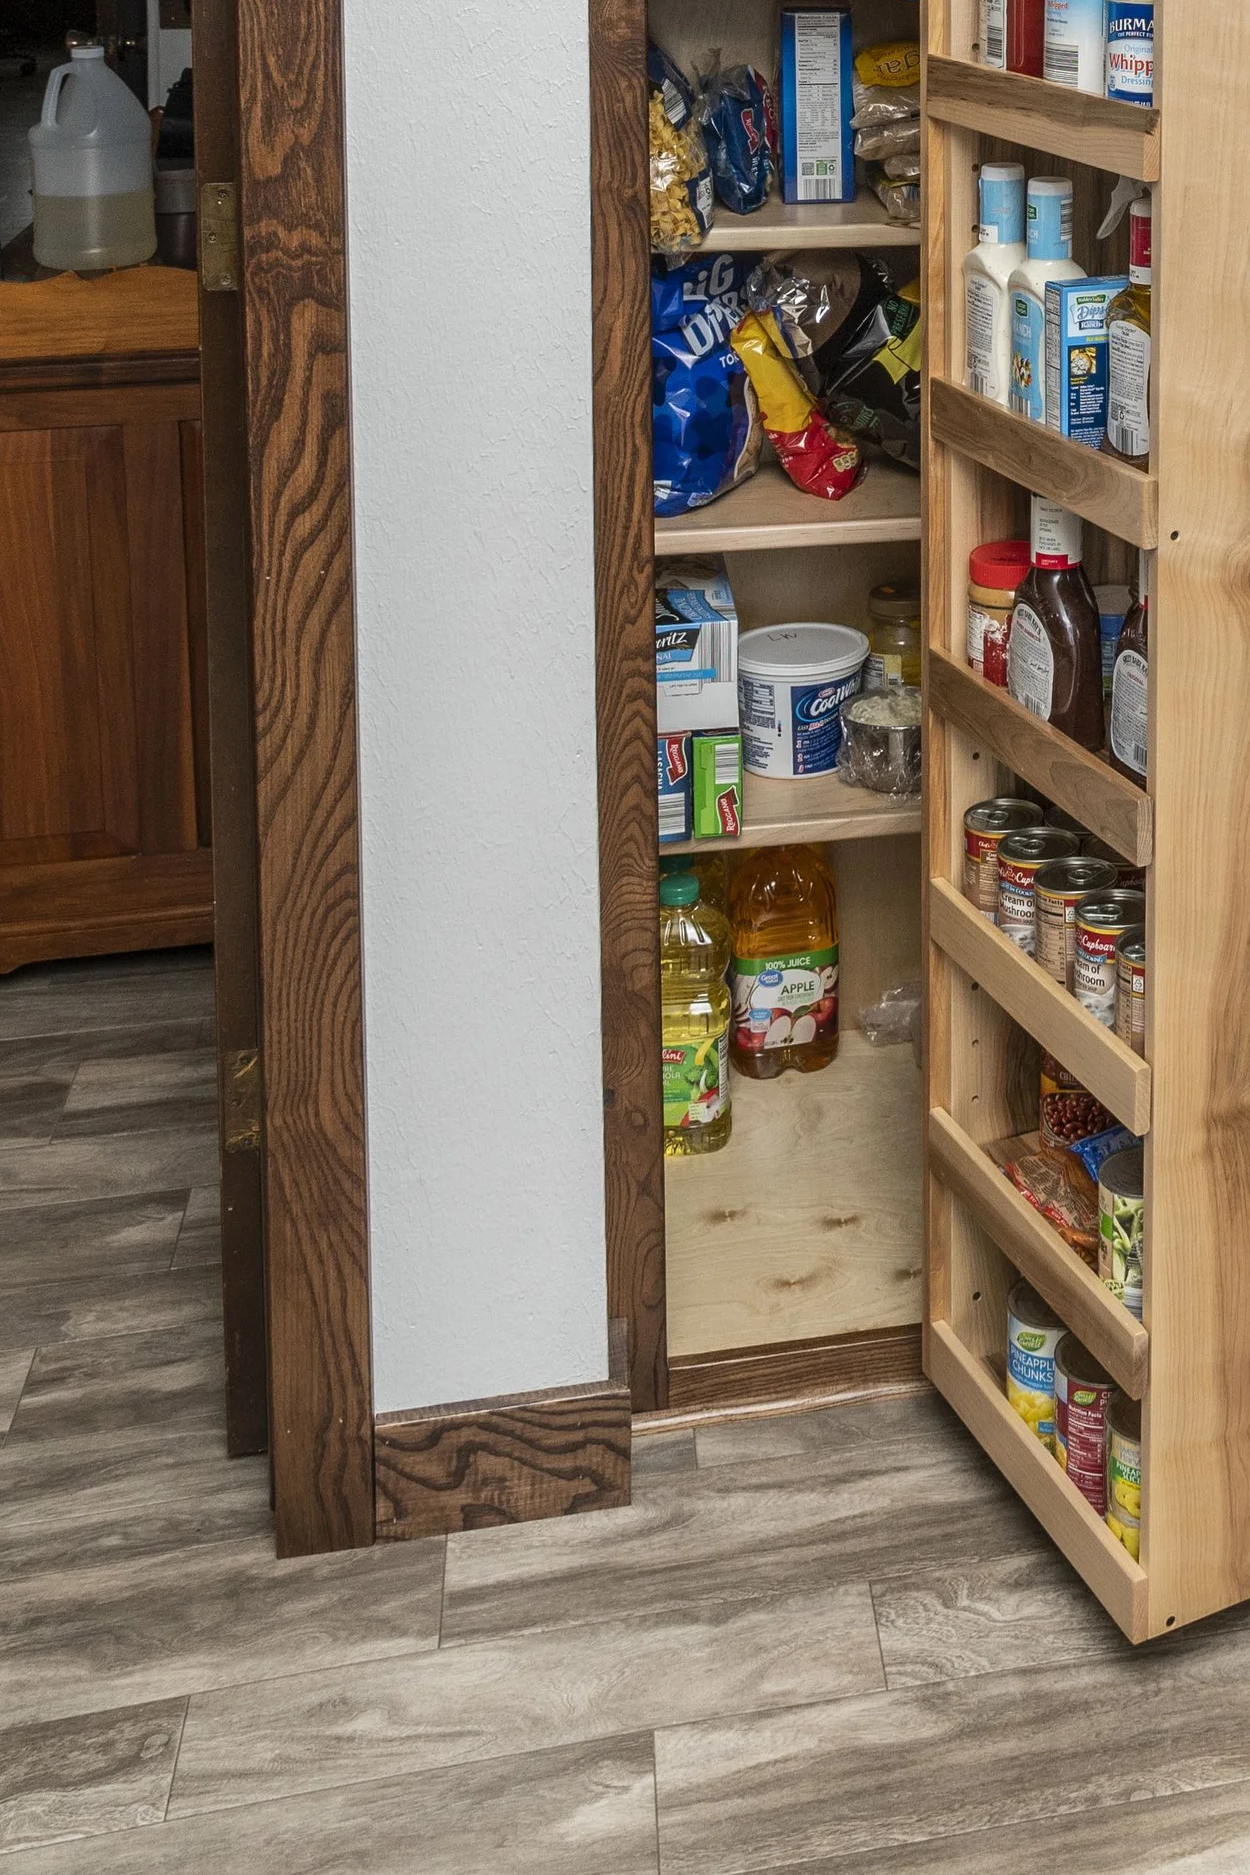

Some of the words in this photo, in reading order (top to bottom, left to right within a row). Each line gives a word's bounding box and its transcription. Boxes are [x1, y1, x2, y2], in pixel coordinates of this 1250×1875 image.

[1122, 76, 1154, 86] Dressin
[720, 798, 736, 832] REGGANO
[1003, 905, 1035, 918] ushroo
[765, 961, 786, 971] 100%
[788, 957, 811, 968] JUICE
[1091, 964, 1101, 975] of
[781, 981, 815, 996] APPLE
[1012, 1360, 1054, 1382] CHUNKS
[1088, 1409, 1102, 1418] Facts
[1122, 1472, 1141, 1484] SLIC
